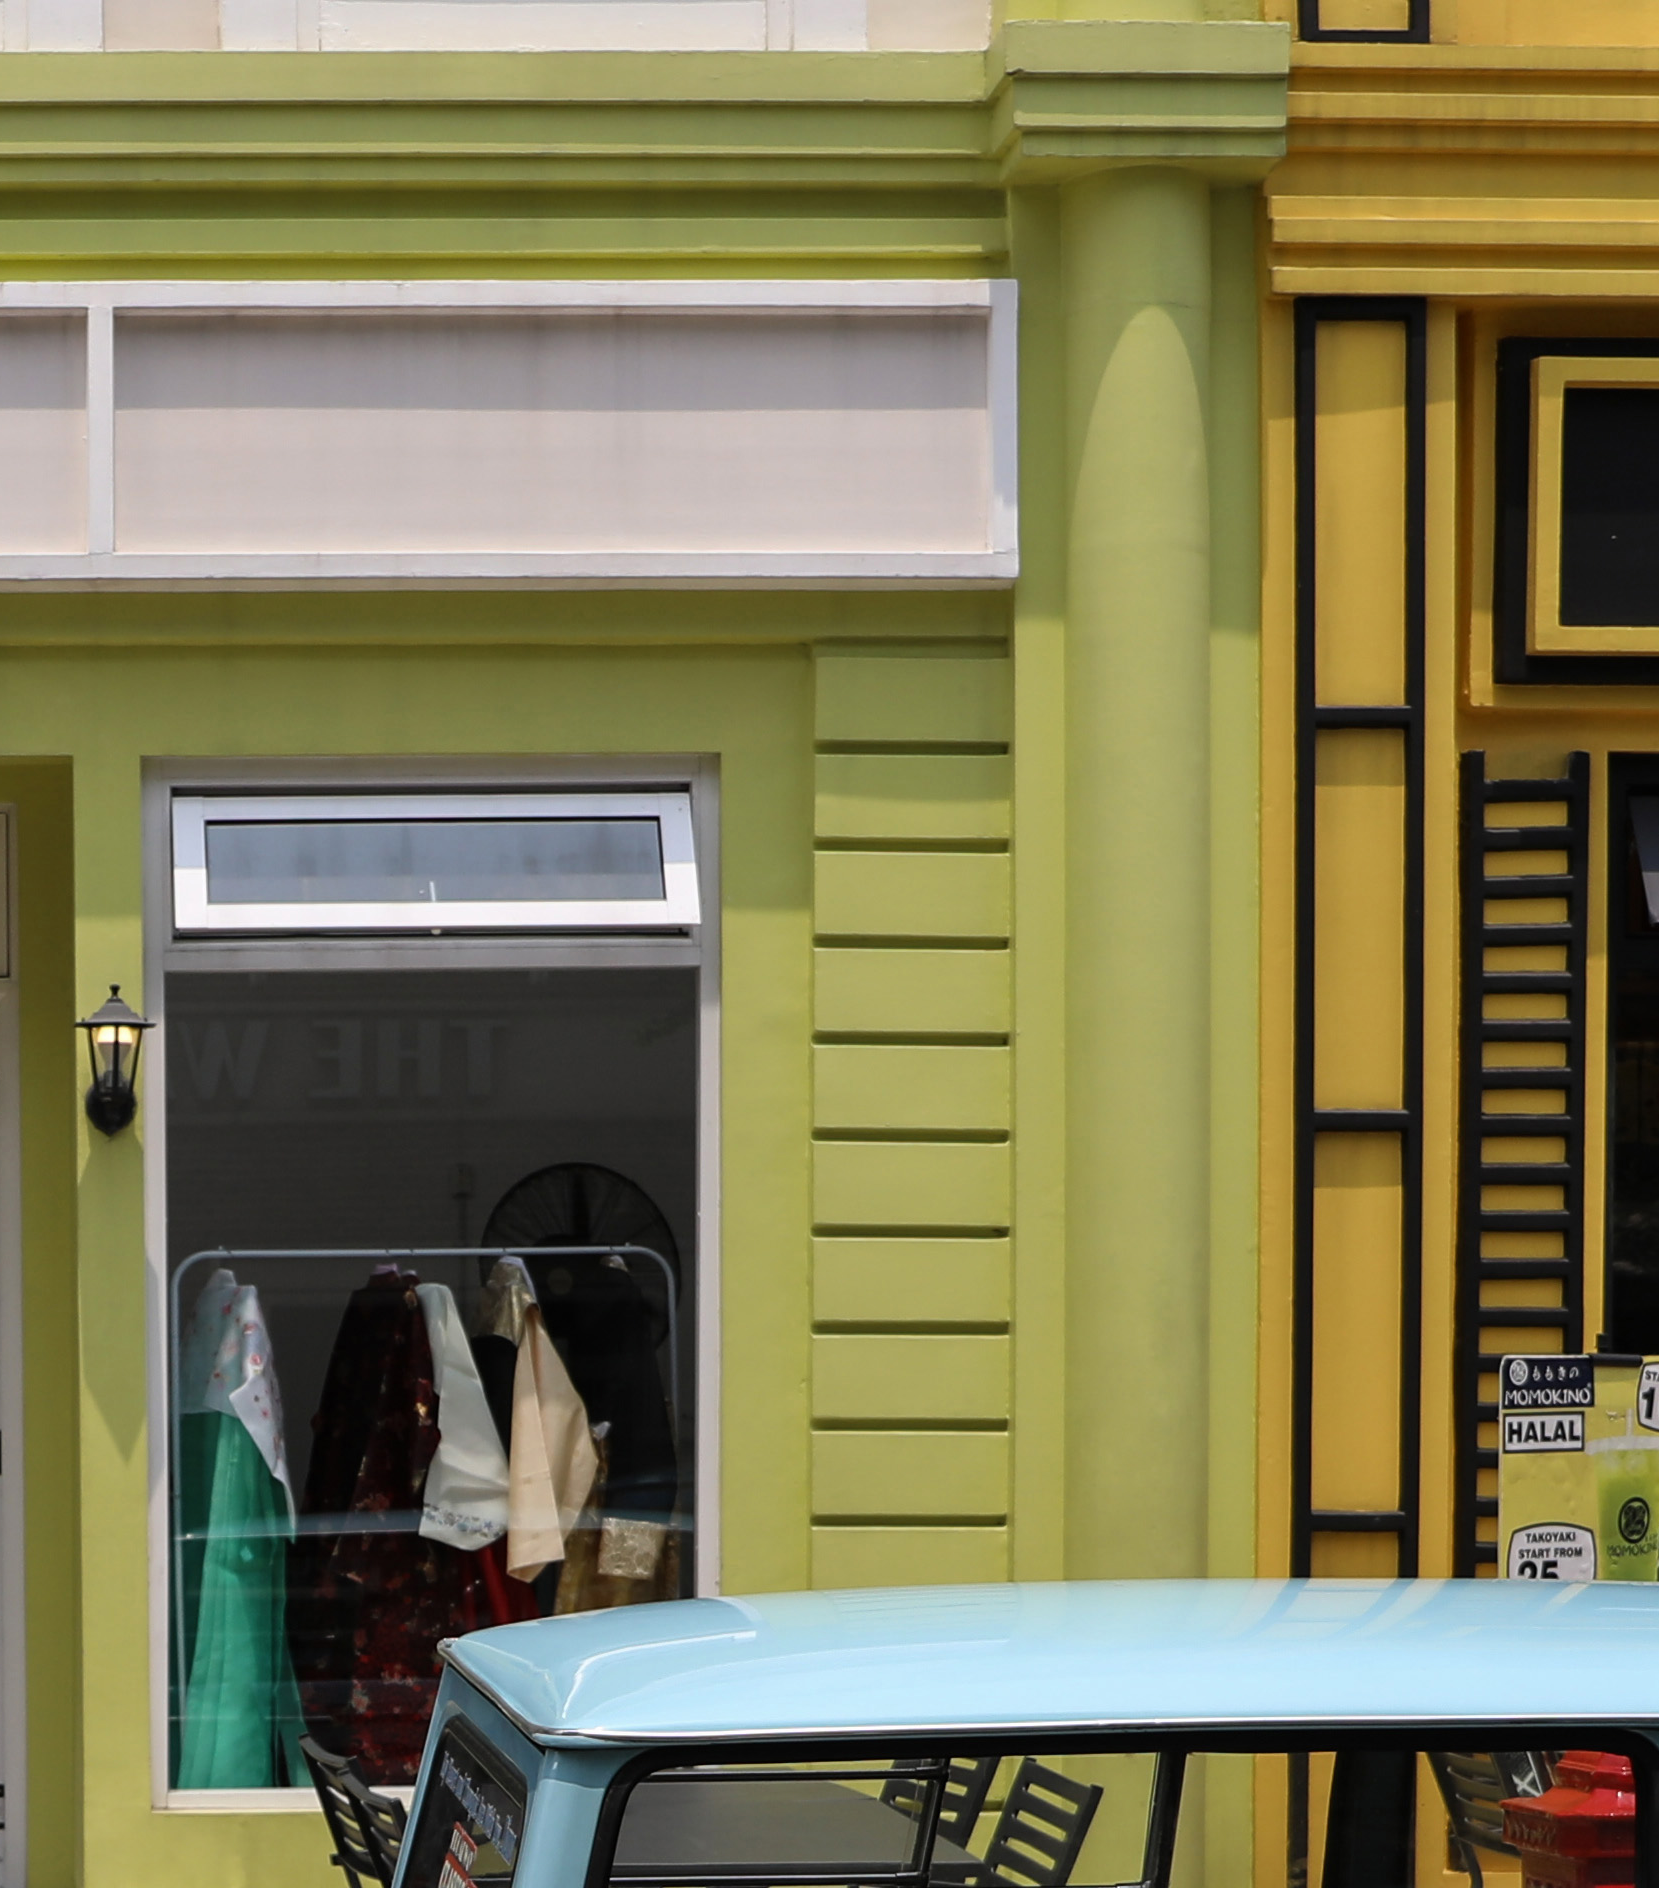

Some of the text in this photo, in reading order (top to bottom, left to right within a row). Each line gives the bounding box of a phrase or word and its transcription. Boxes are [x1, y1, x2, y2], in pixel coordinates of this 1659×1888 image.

[1532, 1365, 1580, 1381] ももきの
[1505, 1387, 1591, 1406] MOMOKINO
[1507, 1420, 1581, 1445] HALAL
[1525, 1532, 1576, 1543] TAKOYAKI
[1518, 1547, 1583, 1559] START FROM
